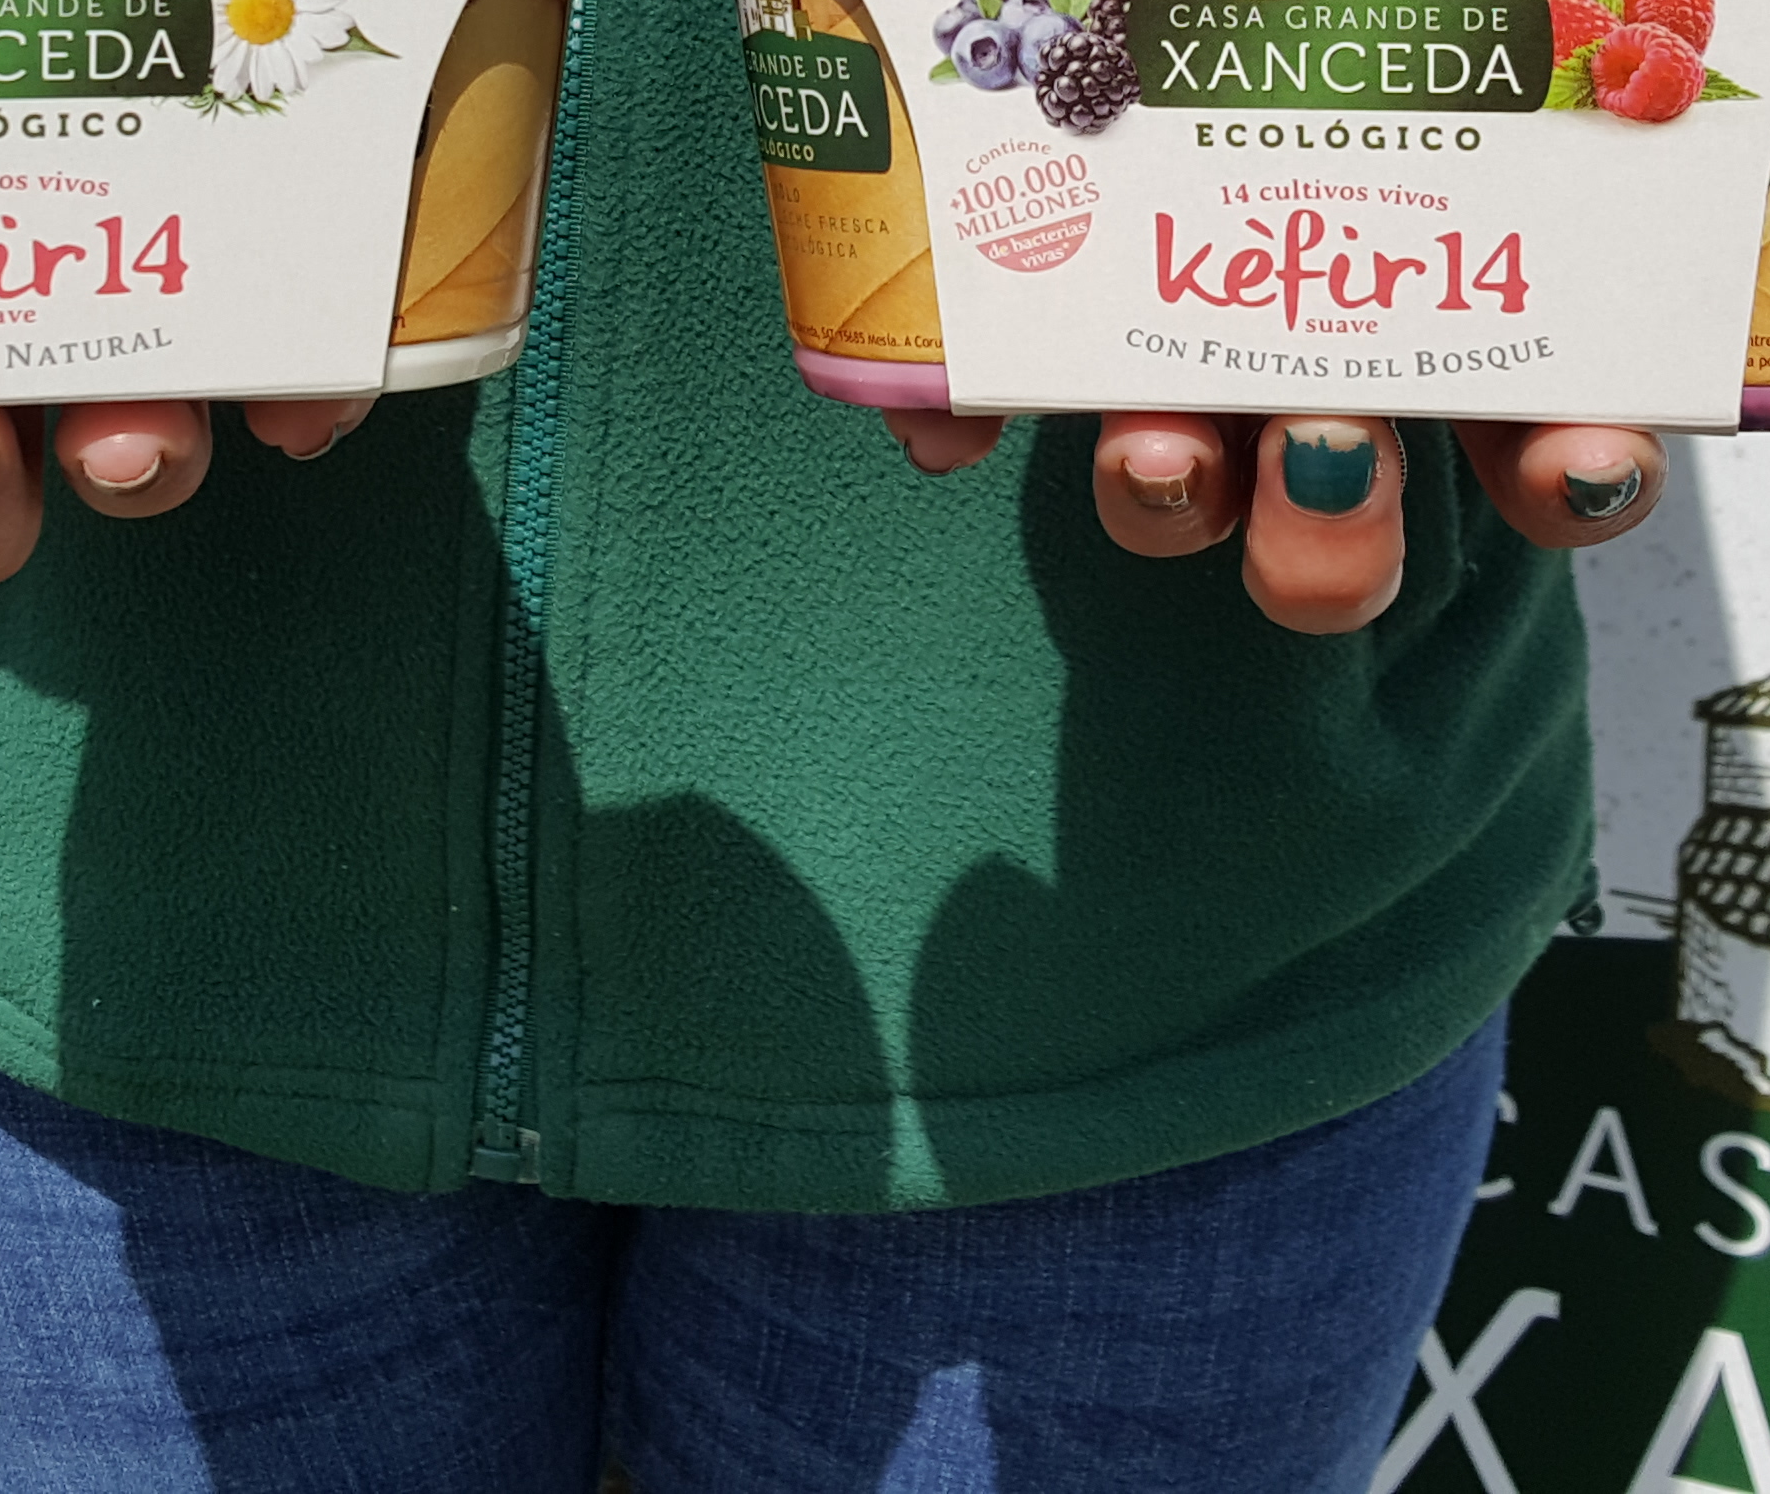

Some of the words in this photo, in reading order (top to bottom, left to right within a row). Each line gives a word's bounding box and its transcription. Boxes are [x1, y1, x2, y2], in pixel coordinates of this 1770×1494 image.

[1169, 4, 1265, 30] CASA
[1285, 5, 1441, 31] GRANDE
[1464, 7, 1509, 32] DE
[816, 55, 851, 80] DE
[1161, 40, 1523, 95] XANCEDA
[1196, 118, 1482, 151] ECOLÓGICO
[966, 138, 1052, 175] Contiene
[40, 171, 110, 197] vivos
[1220, 183, 1250, 205] 14
[1259, 179, 1368, 202] cultivos
[1378, 184, 1449, 211] vivos
[818, 214, 890, 235] FRESCA
[955, 182, 1100, 241] MILLONES
[988, 242, 1011, 260] de
[1010, 221, 1088, 253] bacterias
[904, 335, 912, 346] A
[1305, 317, 1379, 334] suave
[4, 327, 173, 369] NATURAL
[1126, 327, 1187, 359] CON
[1199, 339, 1330, 378] FRUTAS
[1344, 358, 1402, 379] DEL
[1415, 336, 1555, 377] BOSQUE
